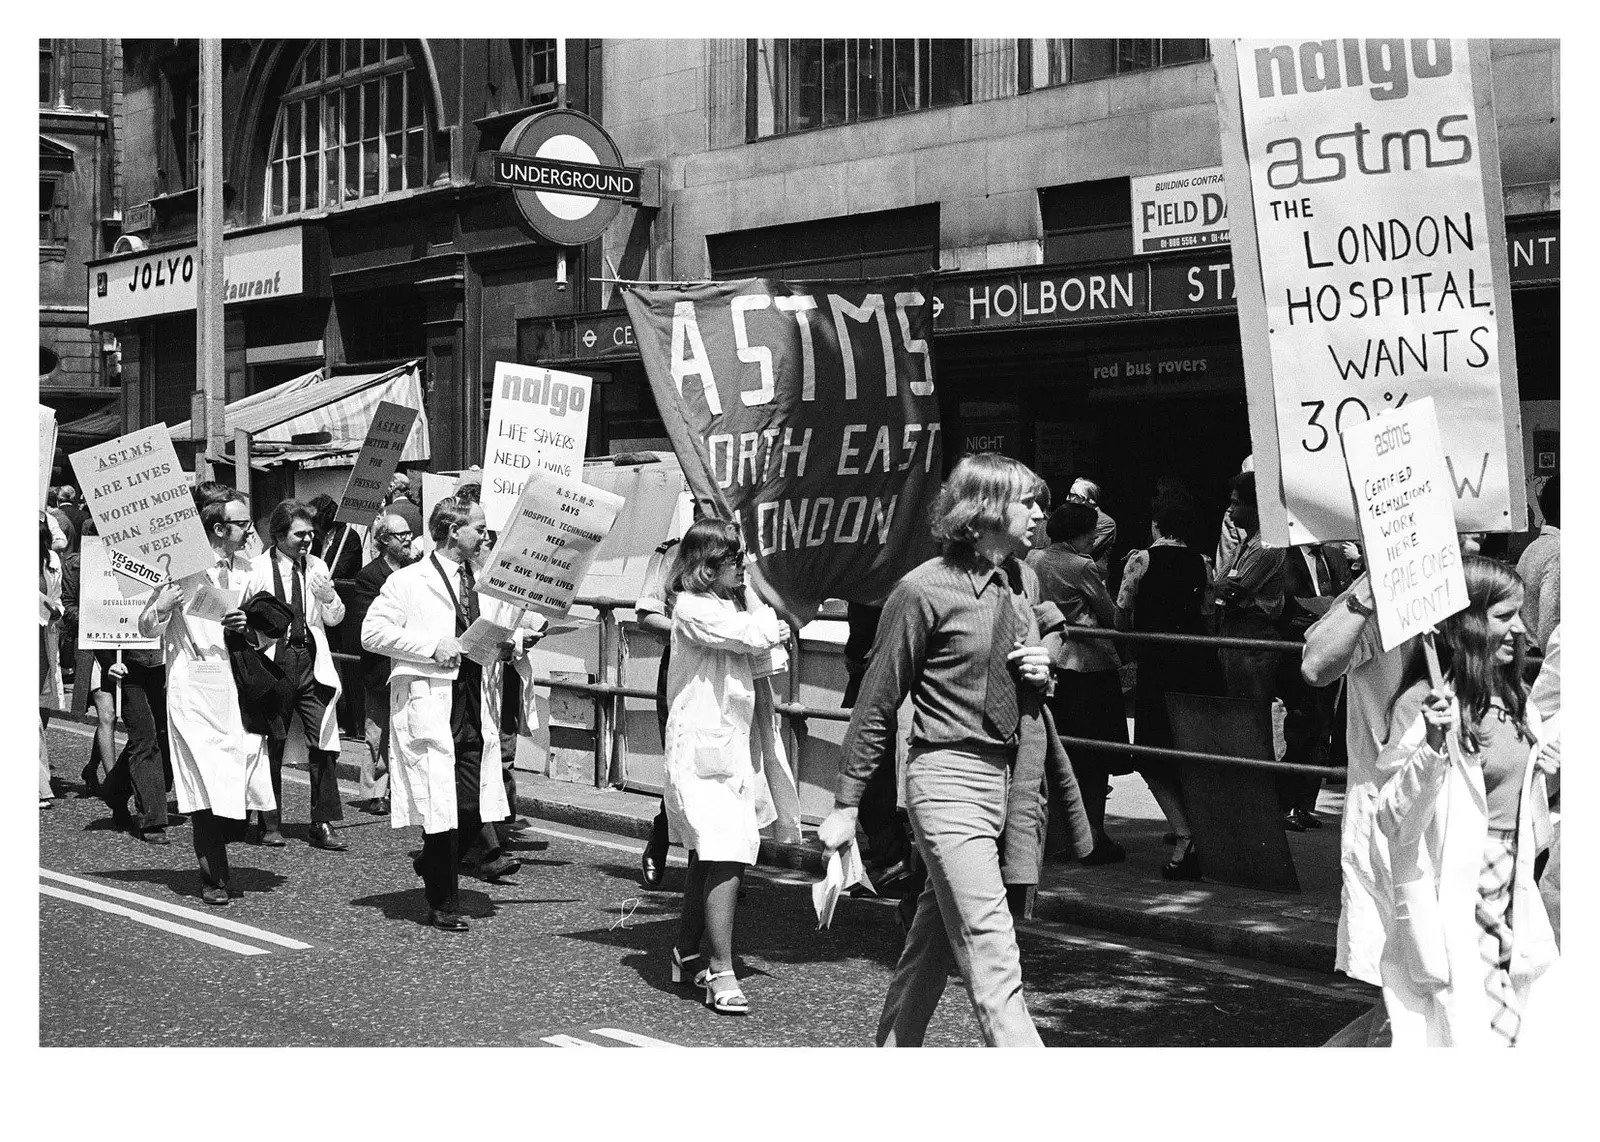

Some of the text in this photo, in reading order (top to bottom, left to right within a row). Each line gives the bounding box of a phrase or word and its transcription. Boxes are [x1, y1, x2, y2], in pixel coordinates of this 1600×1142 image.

[1254, 38, 1453, 101] nalgo
[1266, 114, 1472, 190] astms
[501, 162, 634, 193] UNDERGROUND
[1155, 179, 1190, 192] BUILDING
[1141, 193, 1228, 233] FIELD D
[1270, 198, 1313, 221] THE
[1303, 212, 1474, 269] LONDON
[129, 255, 193, 292] JOLYO
[969, 263, 1238, 320] HOLBORN ST
[1286, 269, 1490, 325] HOSPITAL
[613, 326, 637, 345] CE
[671, 292, 935, 415] ASTMS
[1328, 326, 1489, 380] WANTS
[1093, 358, 1207, 380] red bus rovers
[501, 373, 586, 417] nalgo
[363, 437, 390, 449] BETTER
[498, 419, 575, 450] LIFE SAVERS
[966, 435, 1005, 450] NIGHT
[1374, 422, 1411, 457] astms
[368, 457, 383, 468] FOR
[494, 449, 531, 469] NEED
[700, 422, 941, 489] ORTH EAST
[94, 463, 171, 499] ARE LIVES
[353, 478, 382, 490] PHYSICS
[1364, 466, 1412, 501] CERTIFIED
[99, 484, 189, 523] WORTH MORE
[560, 503, 580, 517] SAYS
[102, 526, 141, 547] THAN
[173, 507, 199, 522] PER
[522, 509, 603, 543] HOSPITAL TECHNICIANS
[1380, 512, 1417, 538] WORK
[111, 549, 129, 564] YES
[139, 532, 184, 555] WEEK
[546, 534, 566, 548] NEED
[1386, 532, 1420, 562] HERE
[521, 548, 572, 570] A FAIR WAGE
[1383, 544, 1456, 602] SANE ONES
[500, 560, 575, 591] WE SAVE YOUR LIVES
[488, 577, 567, 609] NOW SAVE OUR LIVING
